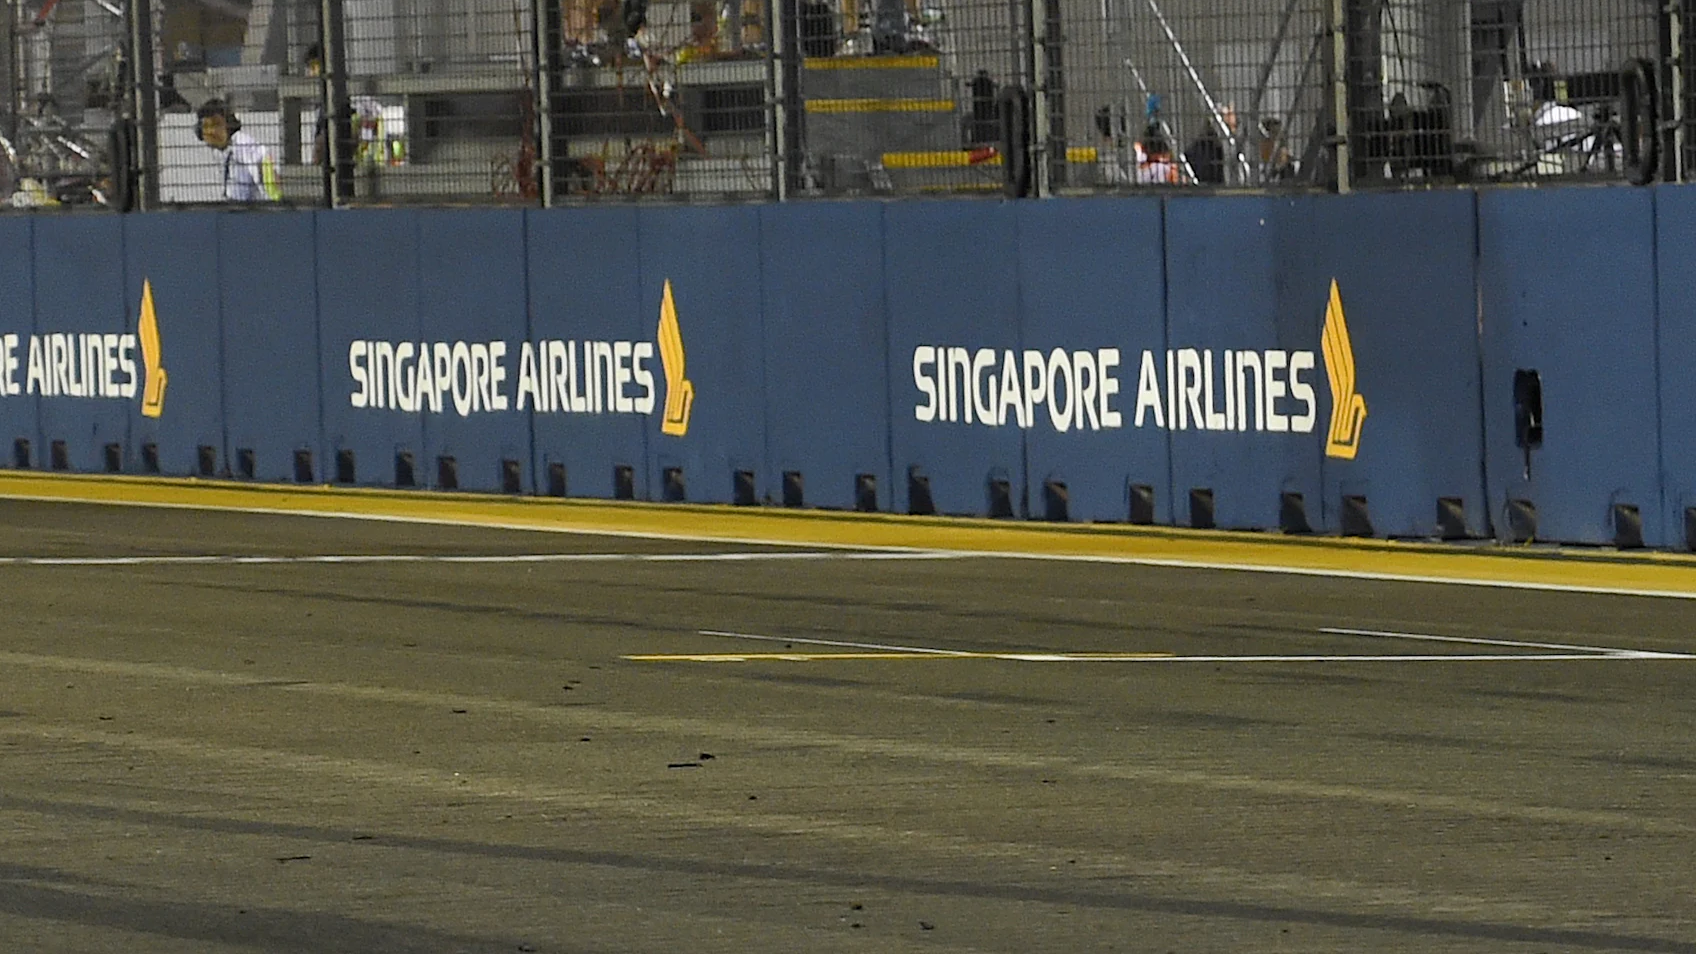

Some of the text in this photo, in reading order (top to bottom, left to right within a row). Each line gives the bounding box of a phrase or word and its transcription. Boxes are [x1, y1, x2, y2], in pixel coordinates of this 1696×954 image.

[26, 333, 137, 398] AIRLINES
[349, 340, 656, 417] SINGAPORE AIRLINES
[913, 346, 1316, 433] SINGAPORE AIRLINES
